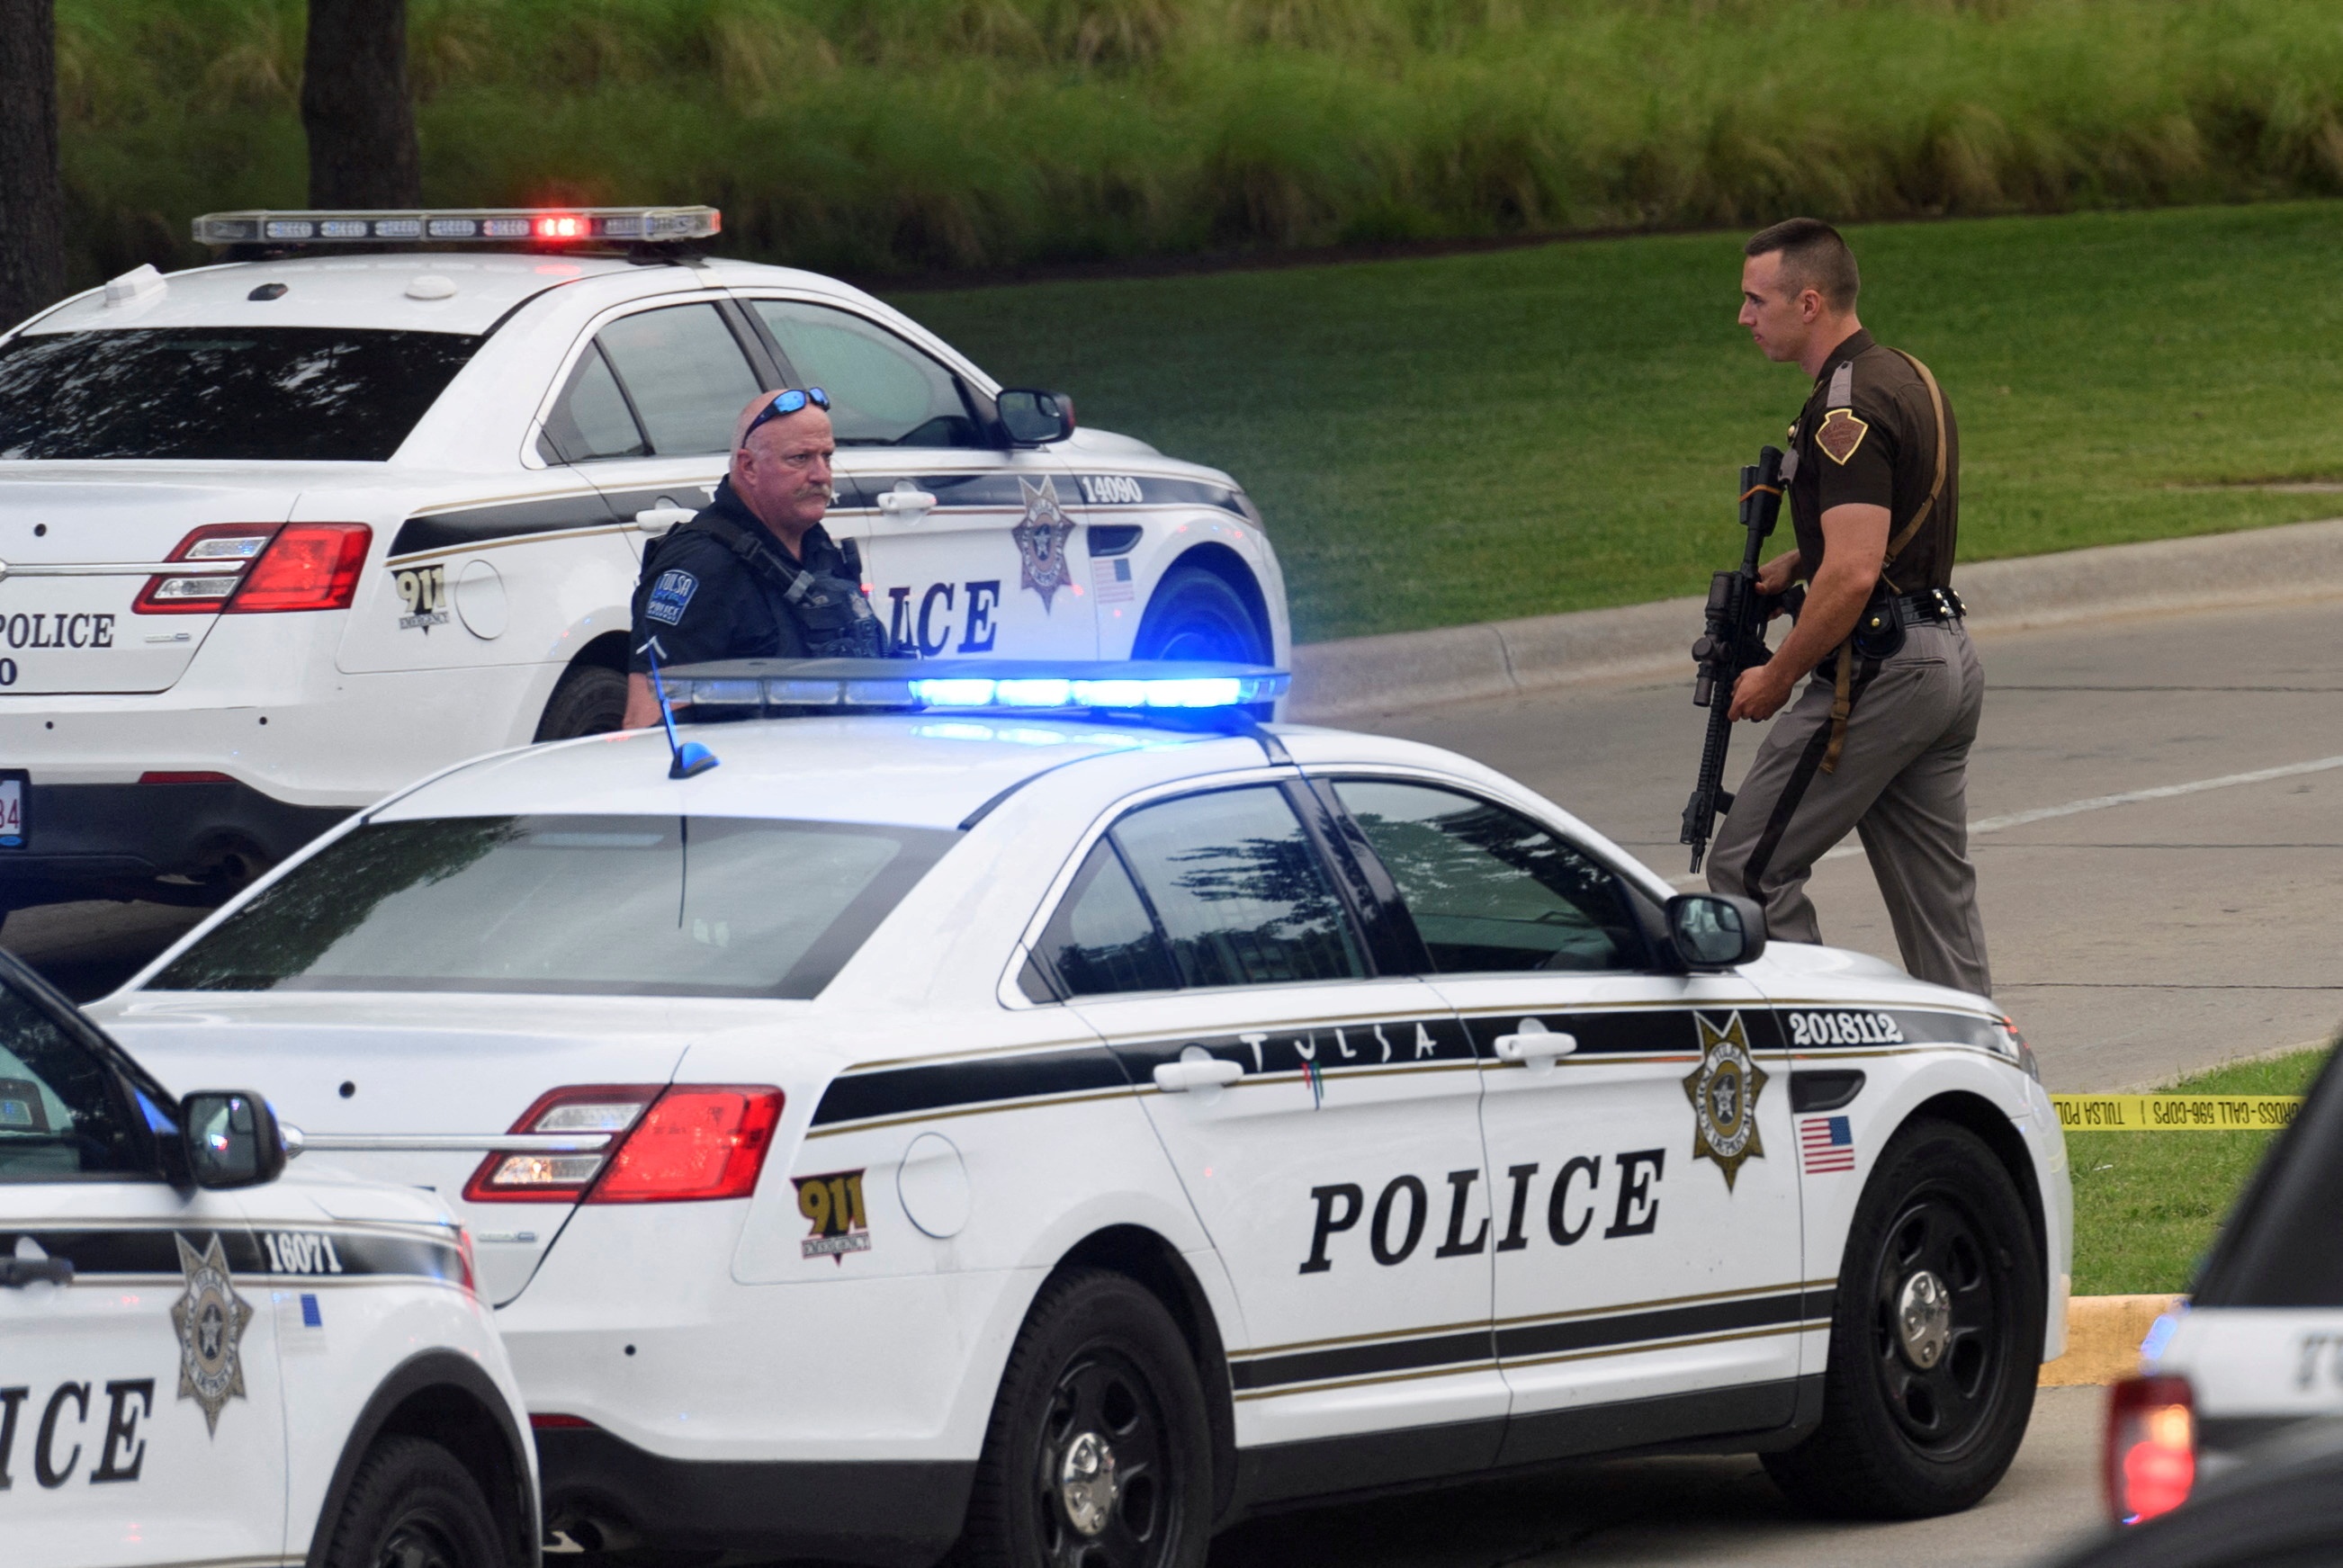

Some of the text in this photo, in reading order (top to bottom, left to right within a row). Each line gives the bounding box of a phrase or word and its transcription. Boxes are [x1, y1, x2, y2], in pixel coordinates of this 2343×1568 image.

[1082, 477, 1144, 503] 14090
[396, 568, 446, 613] 911
[659, 573, 693, 597] TULSA
[1789, 1012, 1905, 1044] 2018112
[1240, 1022, 1438, 1072] TULSA
[2052, 1102, 2081, 1124] POL
[2084, 1102, 2125, 1124] TULSA
[2153, 1101, 2215, 1124] 596-COPS
[798, 1175, 866, 1235] 911
[1298, 1148, 1666, 1275] POLICE
[265, 1232, 342, 1272] 16071
[0, 1378, 156, 1492] ICE
